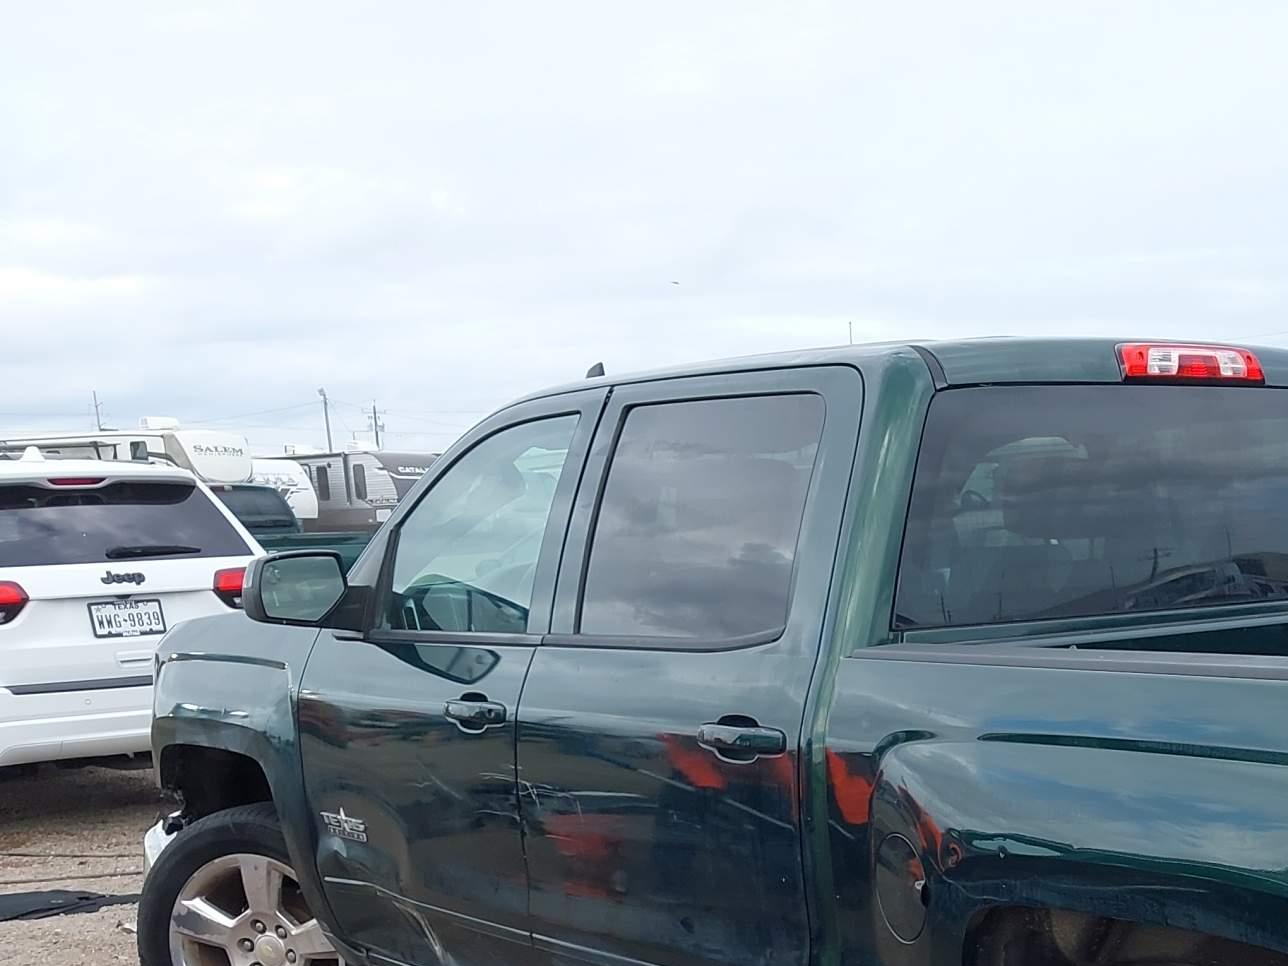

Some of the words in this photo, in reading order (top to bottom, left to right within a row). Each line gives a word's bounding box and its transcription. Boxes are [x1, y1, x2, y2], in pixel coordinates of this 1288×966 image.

[193, 445, 244, 455] SALEM
[100, 569, 146, 586] Jeep
[113, 601, 140, 611] TEXAS
